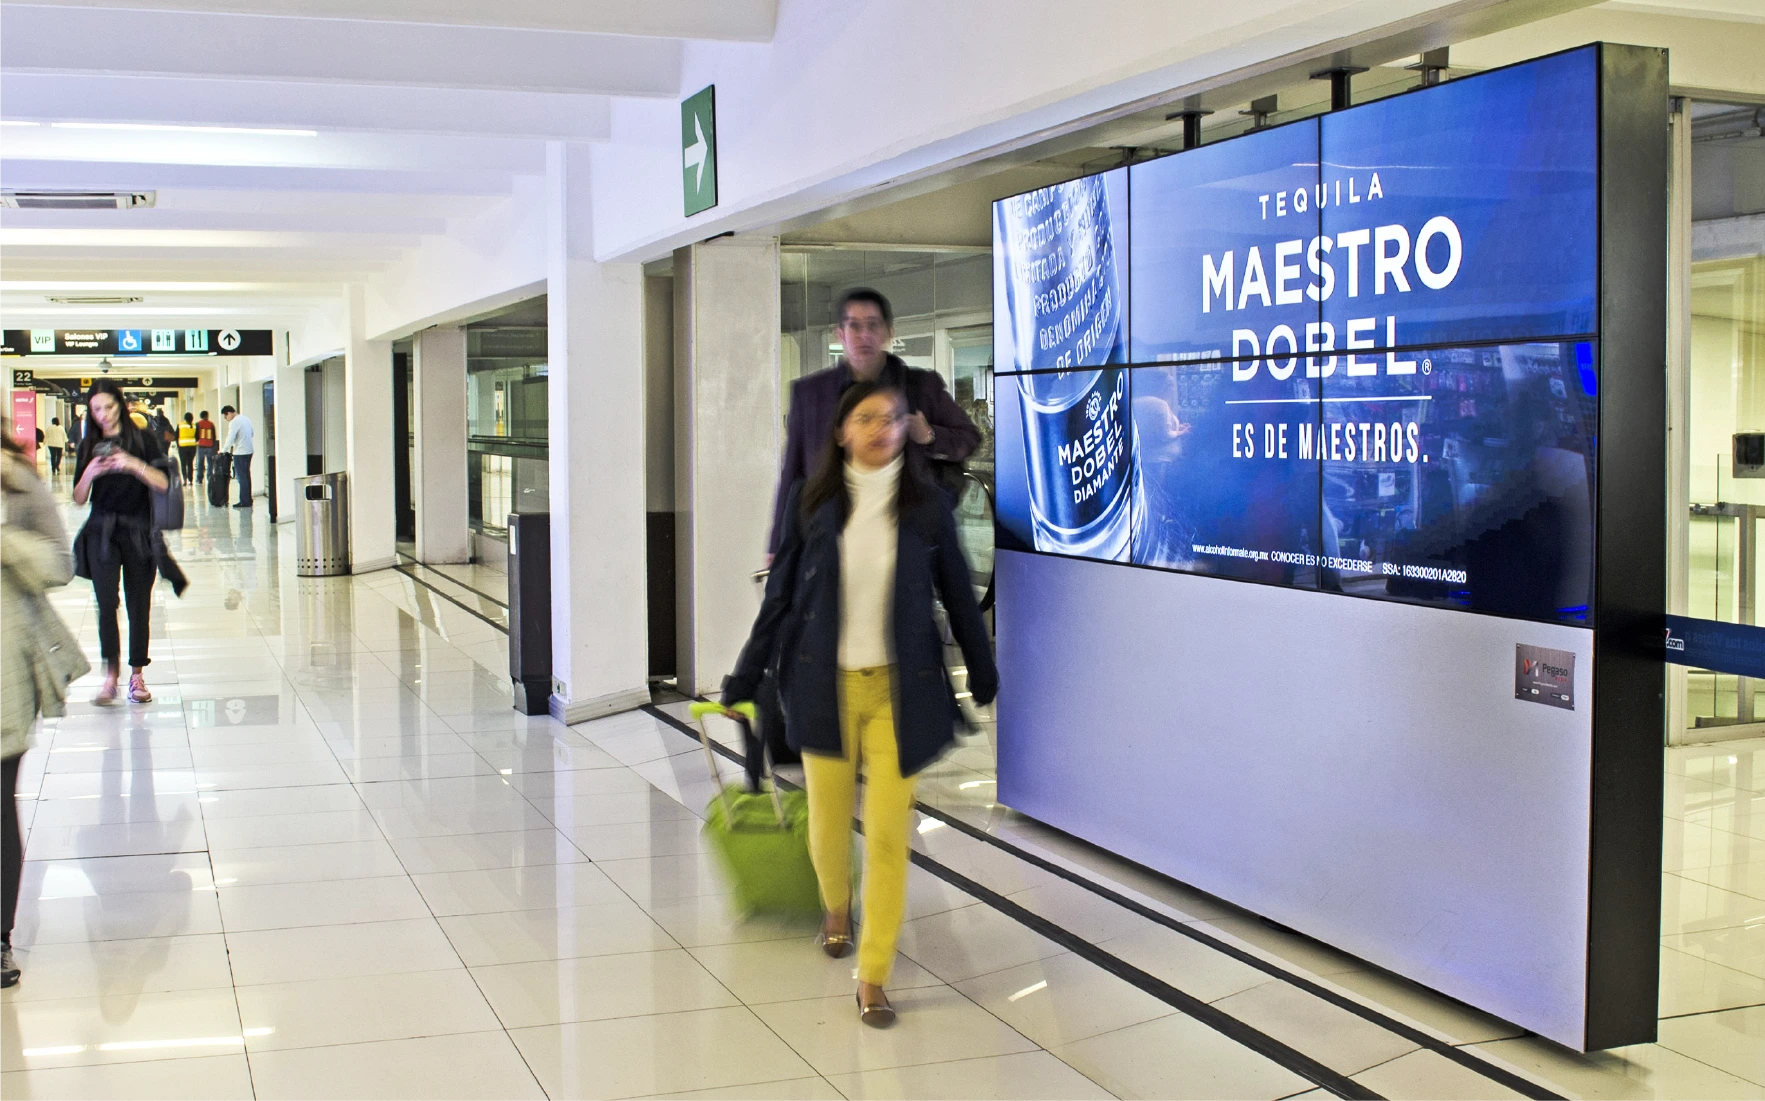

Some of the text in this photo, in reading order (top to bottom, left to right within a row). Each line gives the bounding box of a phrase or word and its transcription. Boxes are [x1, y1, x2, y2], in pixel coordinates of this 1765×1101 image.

[1258, 172, 1384, 220] TEQUILA
[1202, 215, 1462, 314] MAESTRO
[34, 336, 51, 344] VIP
[16, 372, 31, 382] 22
[1057, 371, 1124, 466] MAESTRO
[1071, 420, 1122, 486] DOBEL
[1232, 422, 1428, 463] ES DE MAESTROS.
[1074, 438, 1124, 504] DIAMANTE
[1270, 550, 1304, 565] CONOCER
[1305, 554, 1316, 566] ES
[1328, 556, 1373, 573] EXCEDERSE
[1382, 562, 1401, 576] SSA:
[1542, 663, 1568, 678] Pegaso
